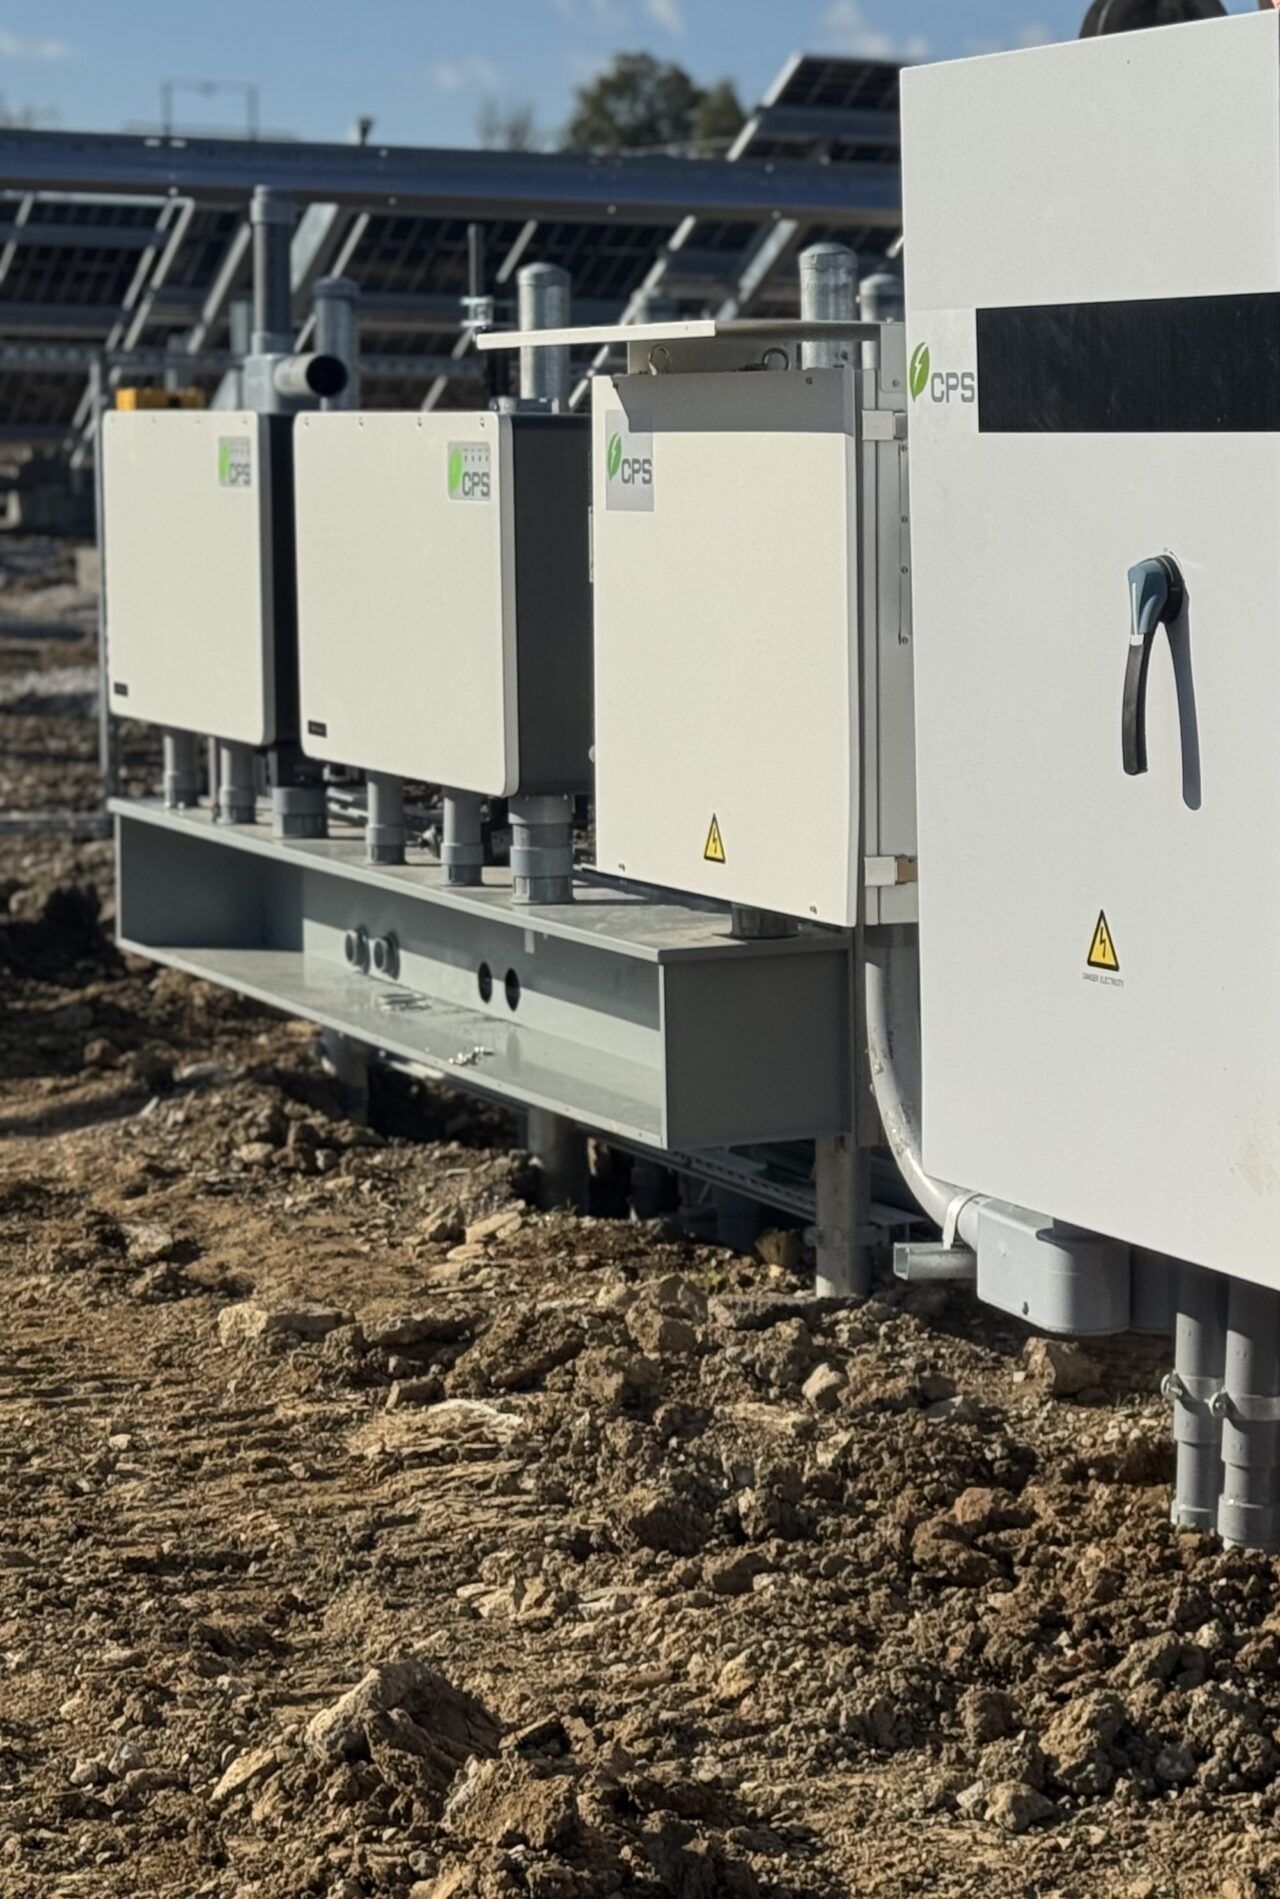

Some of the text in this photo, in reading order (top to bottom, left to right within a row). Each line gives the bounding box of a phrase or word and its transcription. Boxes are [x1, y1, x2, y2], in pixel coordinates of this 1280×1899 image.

[931, 371, 975, 403] CPS
[229, 462, 251, 485] CPS
[462, 471, 490, 497] CPS
[621, 458, 652, 485] CPS
